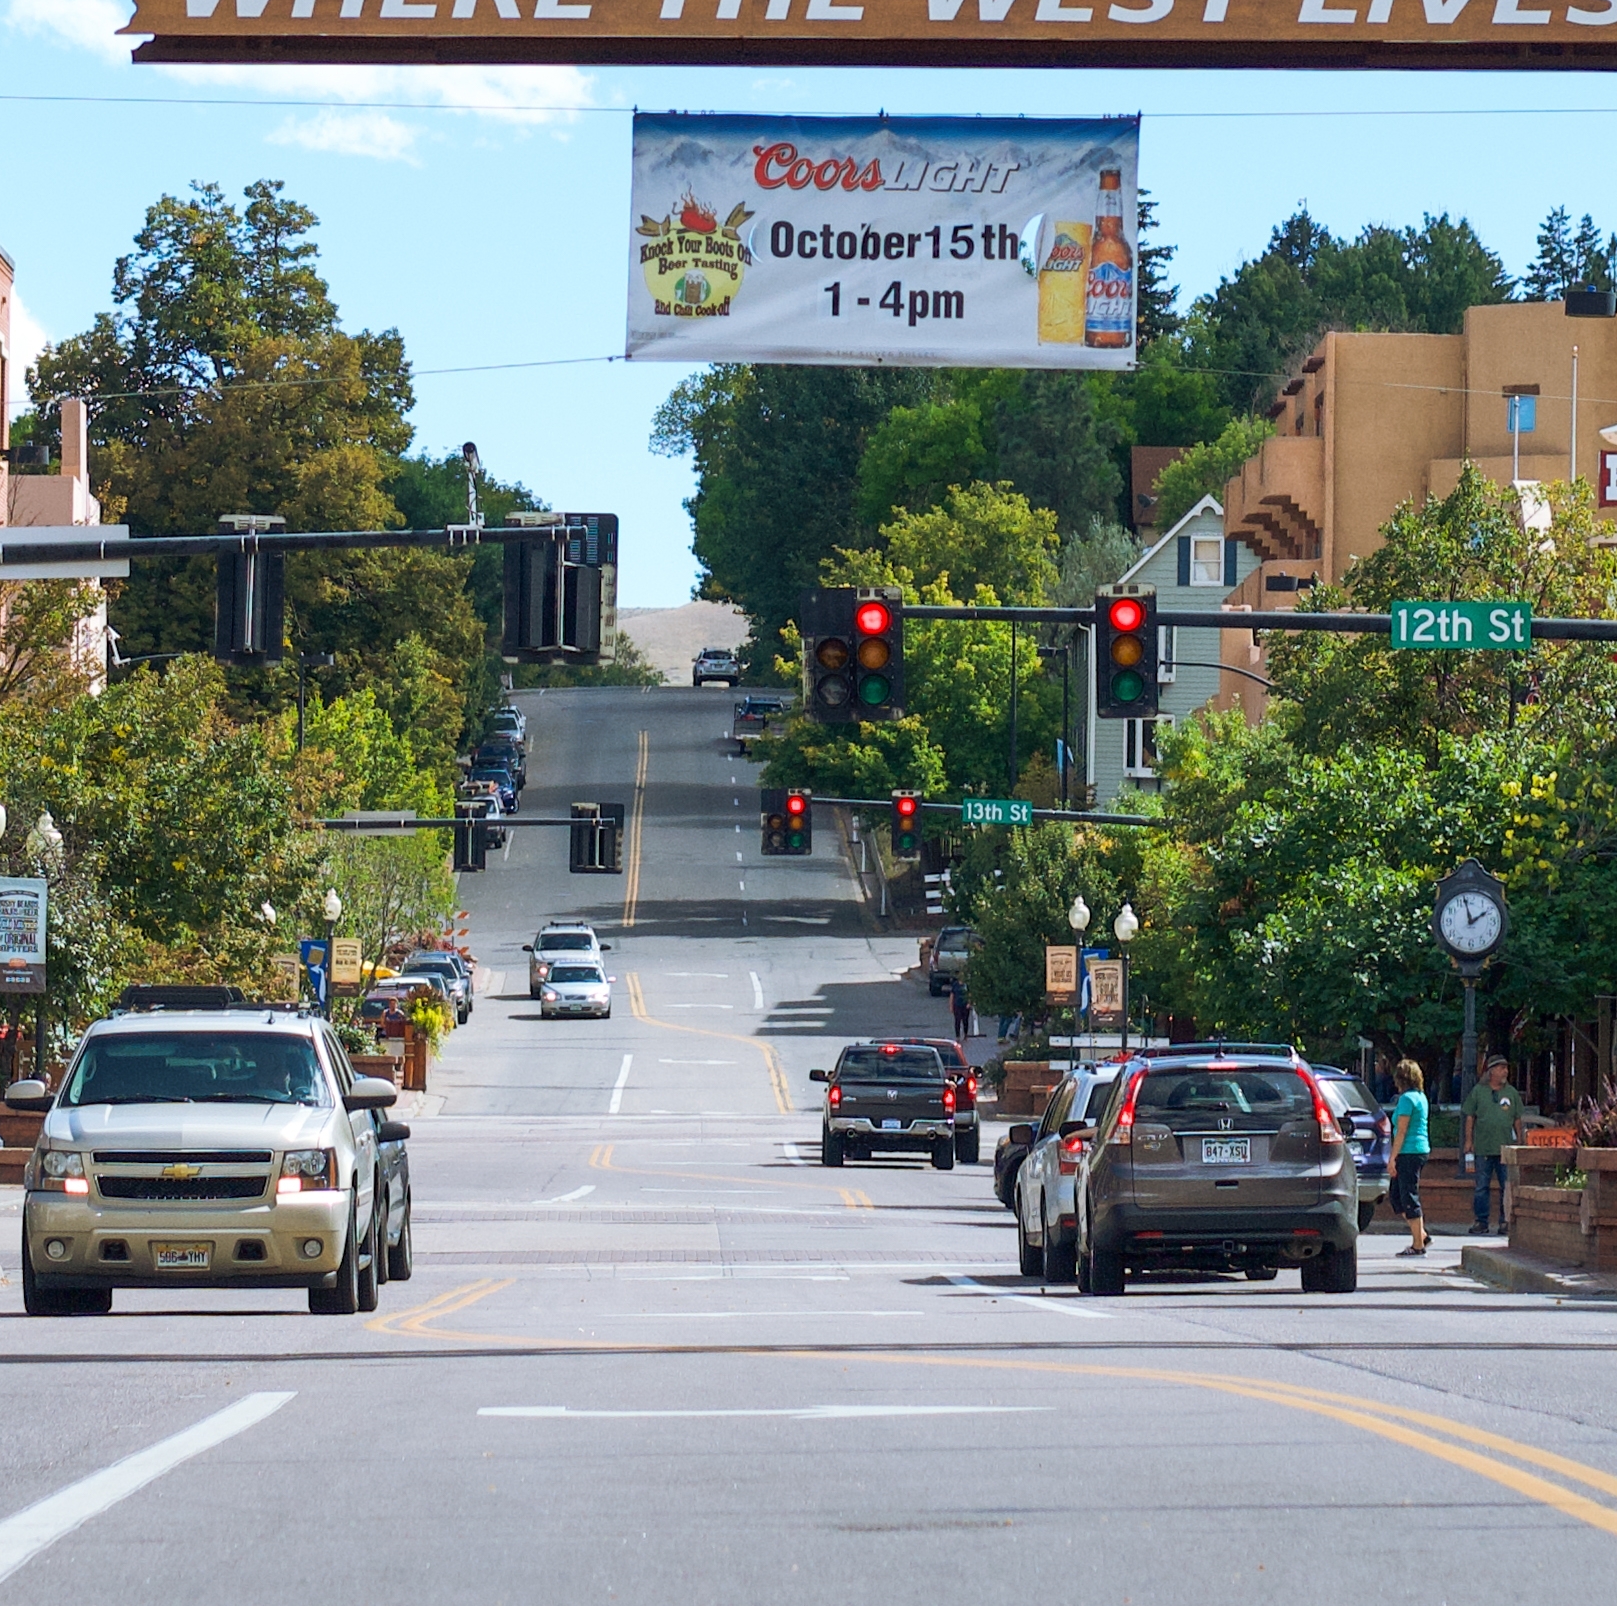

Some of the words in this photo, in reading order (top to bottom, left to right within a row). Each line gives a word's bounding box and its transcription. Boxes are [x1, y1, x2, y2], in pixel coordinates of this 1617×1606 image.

[753, 142, 884, 191] Coors
[883, 162, 1021, 193] LIGHT
[640, 237, 674, 264] Knock
[677, 236, 702, 254] Your
[706, 237, 734, 258] Boots
[658, 257, 688, 275] Beer
[692, 258, 738, 281] Tasting
[1398, 608, 1473, 642] 12th
[1488, 608, 1525, 643] St
[967, 802, 1003, 821] 13th
[1009, 804, 1028, 822] St
[1446, 918, 1452, 926] 9
[1490, 917, 1496, 926] 3
[1468, 939, 1475, 948] 6
